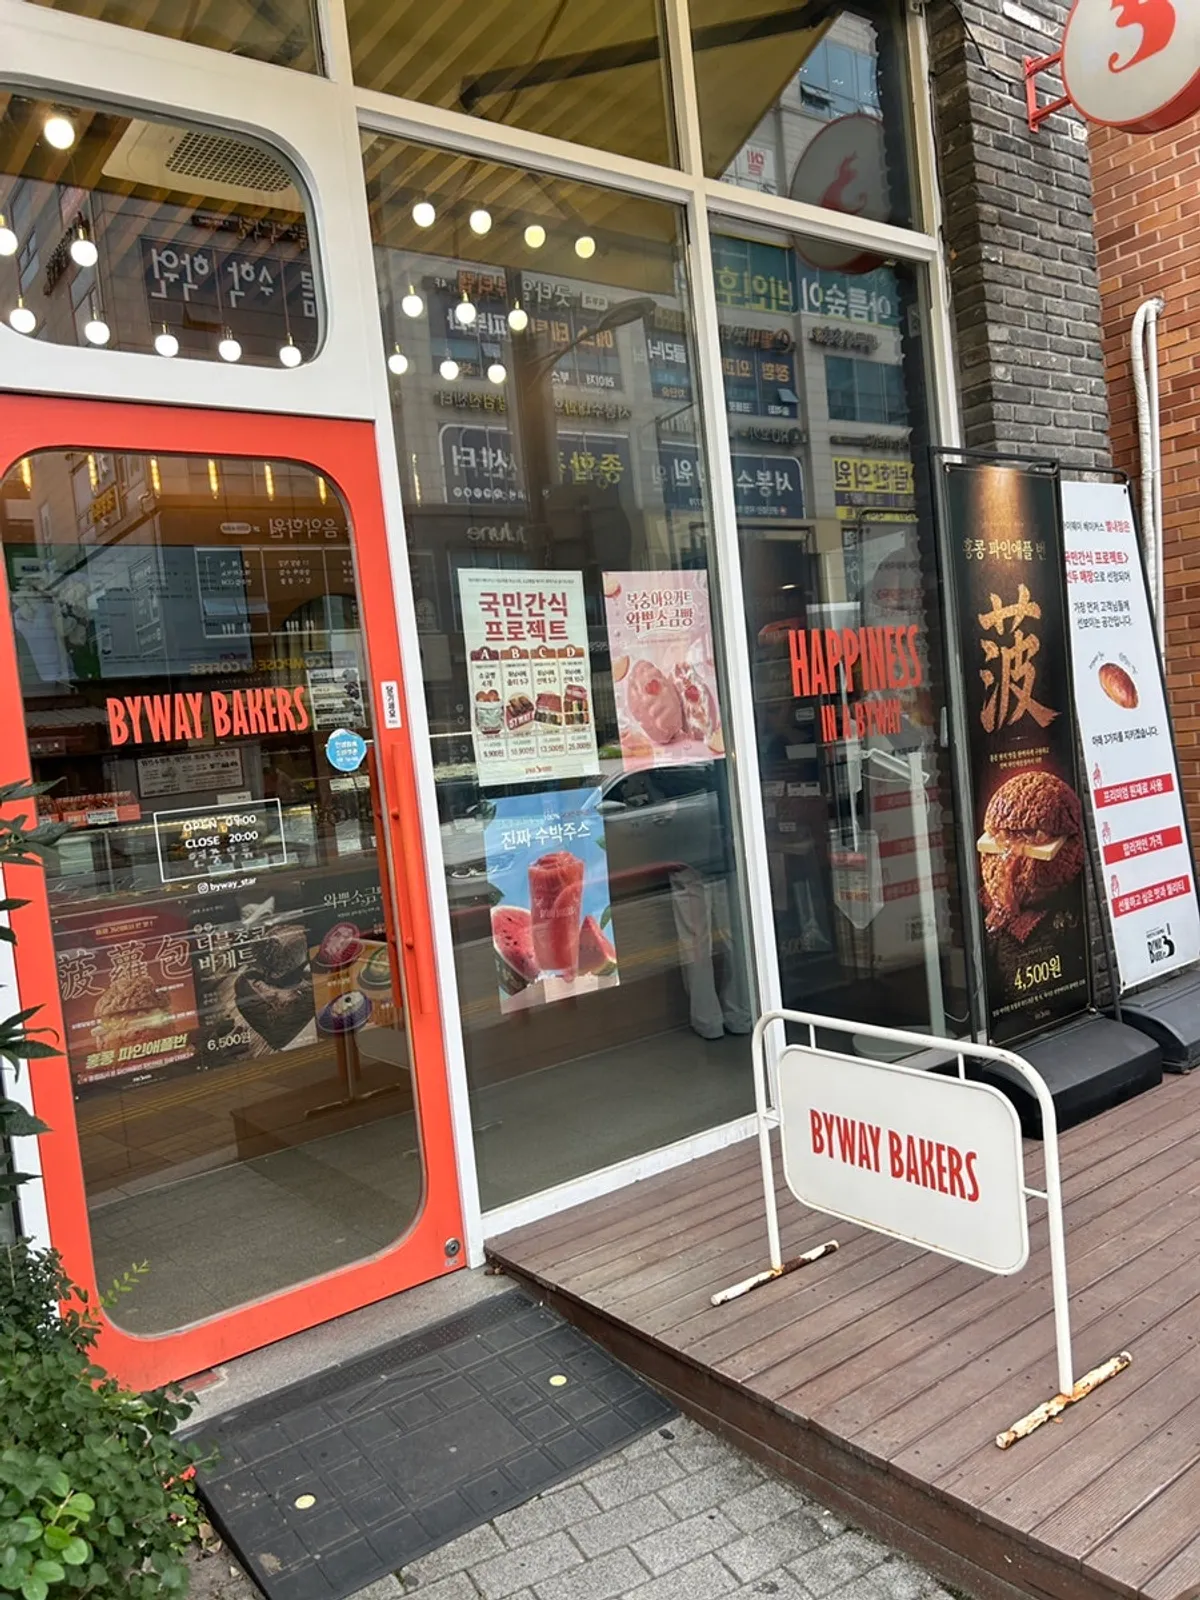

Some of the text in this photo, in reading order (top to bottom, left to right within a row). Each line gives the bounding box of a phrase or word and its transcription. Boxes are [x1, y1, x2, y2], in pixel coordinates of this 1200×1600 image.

[963, 537, 1047, 561] 홍콩 파인애플 번
[478, 591, 568, 617] 국민간식
[626, 590, 692, 610] 복숭아요거트
[485, 619, 569, 643] 프로젝트
[480, 648, 489, 660] A
[511, 647, 520, 659] B
[538, 647, 547, 658] C
[567, 646, 576, 657] D
[788, 623, 922, 698] HAPPINESS
[106, 691, 206, 746] BYWAY
[209, 687, 310, 737] BAKERS
[820, 699, 903, 742] IN A BYWAY
[1149, 778, 1164, 793] 사용
[183, 814, 257, 831] OPEN 09:00
[185, 830, 258, 849] CLOSE 20:00
[501, 821, 591, 851] 진짜 수박주스
[1148, 834, 1164, 849] 가격
[209, 877, 257, 892] byway_star
[196, 925, 266, 951] 더블초코
[199, 947, 257, 973] 바게트
[1014, 954, 1062, 991] 4,500원
[117, 1033, 188, 1062] 파인애플번
[809, 1108, 979, 1203] BYWAY BAKERS
